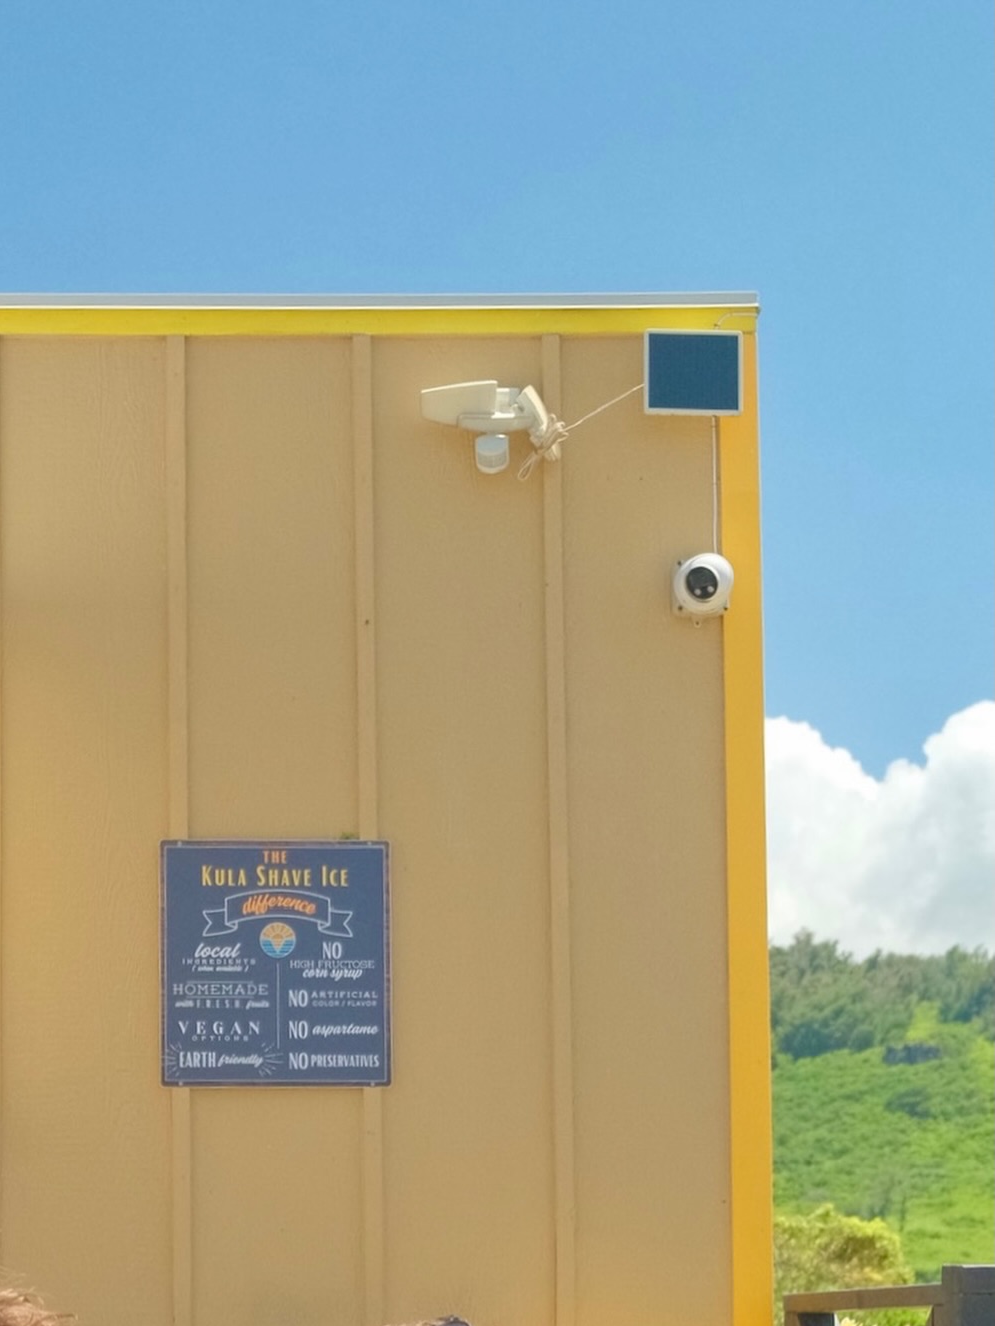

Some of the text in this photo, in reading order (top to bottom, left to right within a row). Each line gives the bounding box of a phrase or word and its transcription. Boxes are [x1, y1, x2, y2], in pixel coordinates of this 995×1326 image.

[263, 850, 287, 864] THE
[242, 893, 316, 915] difference
[194, 942, 241, 958] local
[322, 941, 342, 960] NO
[290, 959, 375, 969] HIGH FRUCTOSE
[302, 968, 363, 981] corn syrup
[173, 983, 269, 996] HOMEMADE
[288, 989, 378, 1008] NO ARTIFICIAL
[178, 1021, 260, 1035] VEGAN
[288, 1020, 379, 1039] NO aspartame
[179, 1051, 263, 1068] EARTH friendly
[288, 1052, 380, 1070] NO PRESERVATIVES
